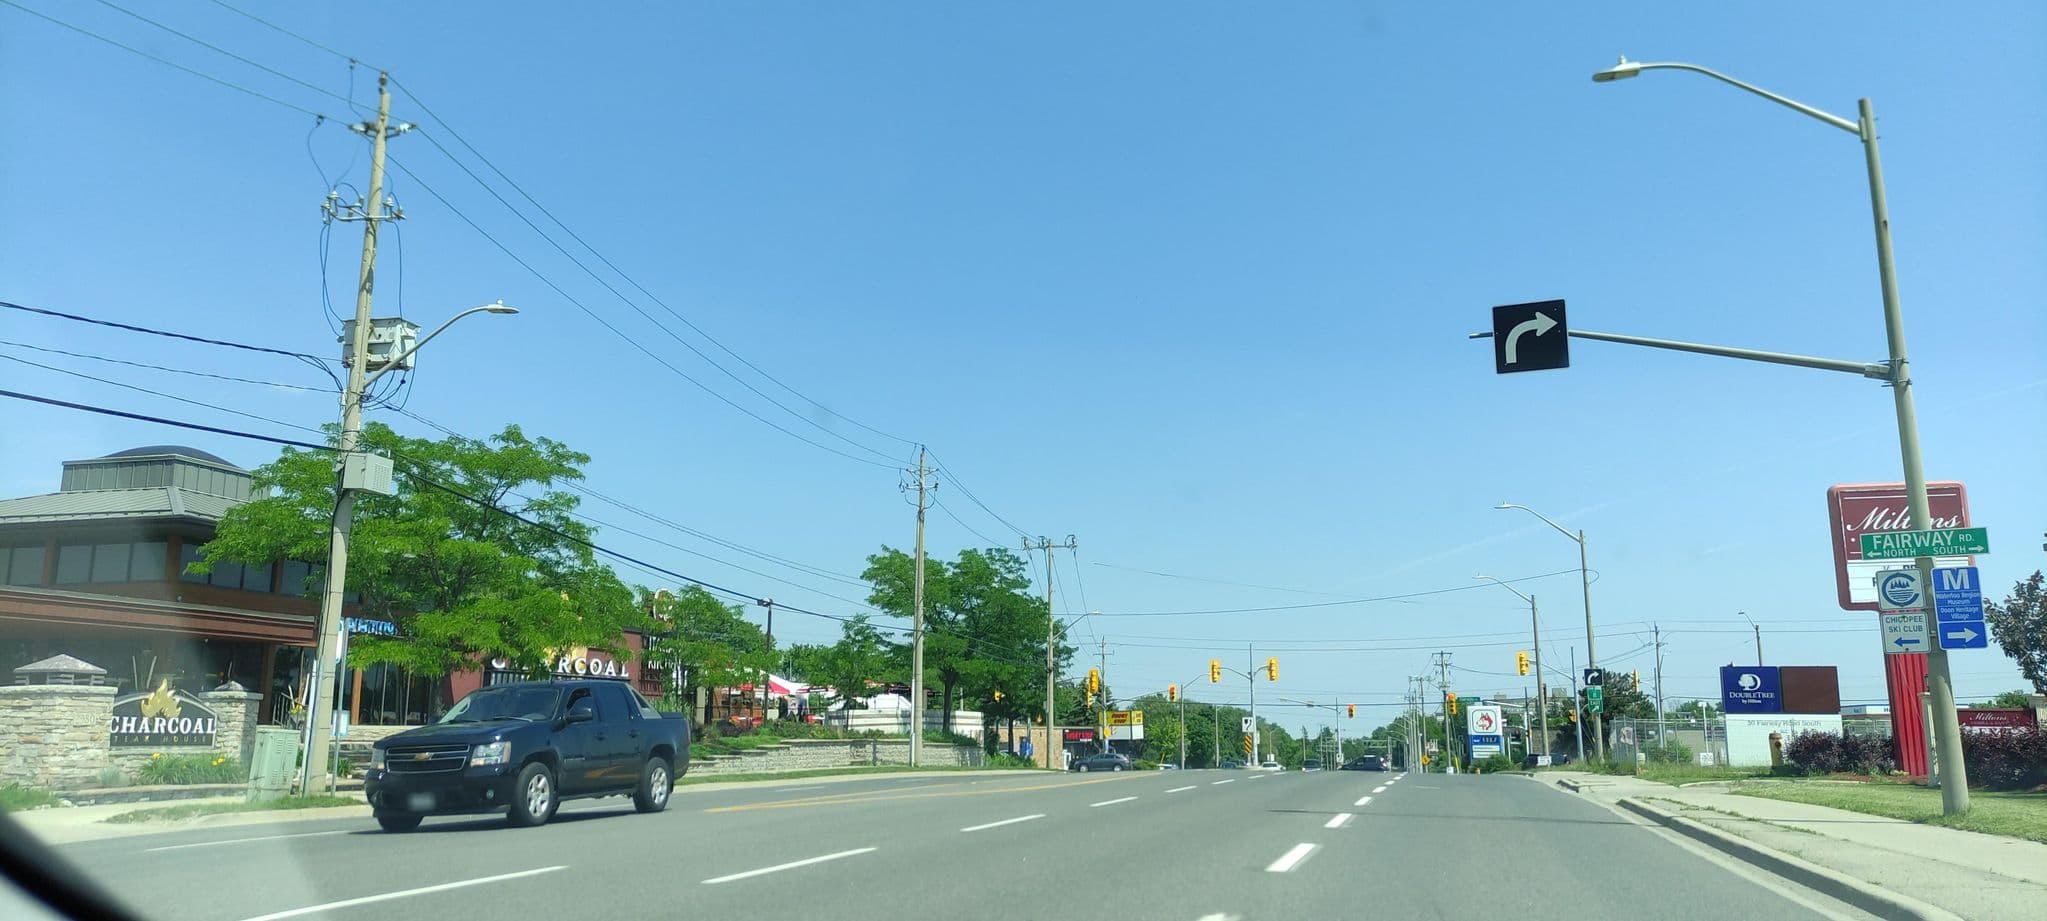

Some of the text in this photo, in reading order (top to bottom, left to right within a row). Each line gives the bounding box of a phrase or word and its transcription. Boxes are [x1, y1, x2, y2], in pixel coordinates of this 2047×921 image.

[1846, 504, 1961, 532] Miltns
[1872, 530, 1975, 550] FAIRWAY RD.
[1882, 545, 1967, 558] NORTH SOUTH
[1941, 568, 1970, 590] M
[1885, 615, 1923, 623] CHICOPEE
[1888, 624, 1923, 633] SKI CLUB
[111, 716, 217, 734] CHARCOAL
[163, 735, 207, 743] HOUSE
